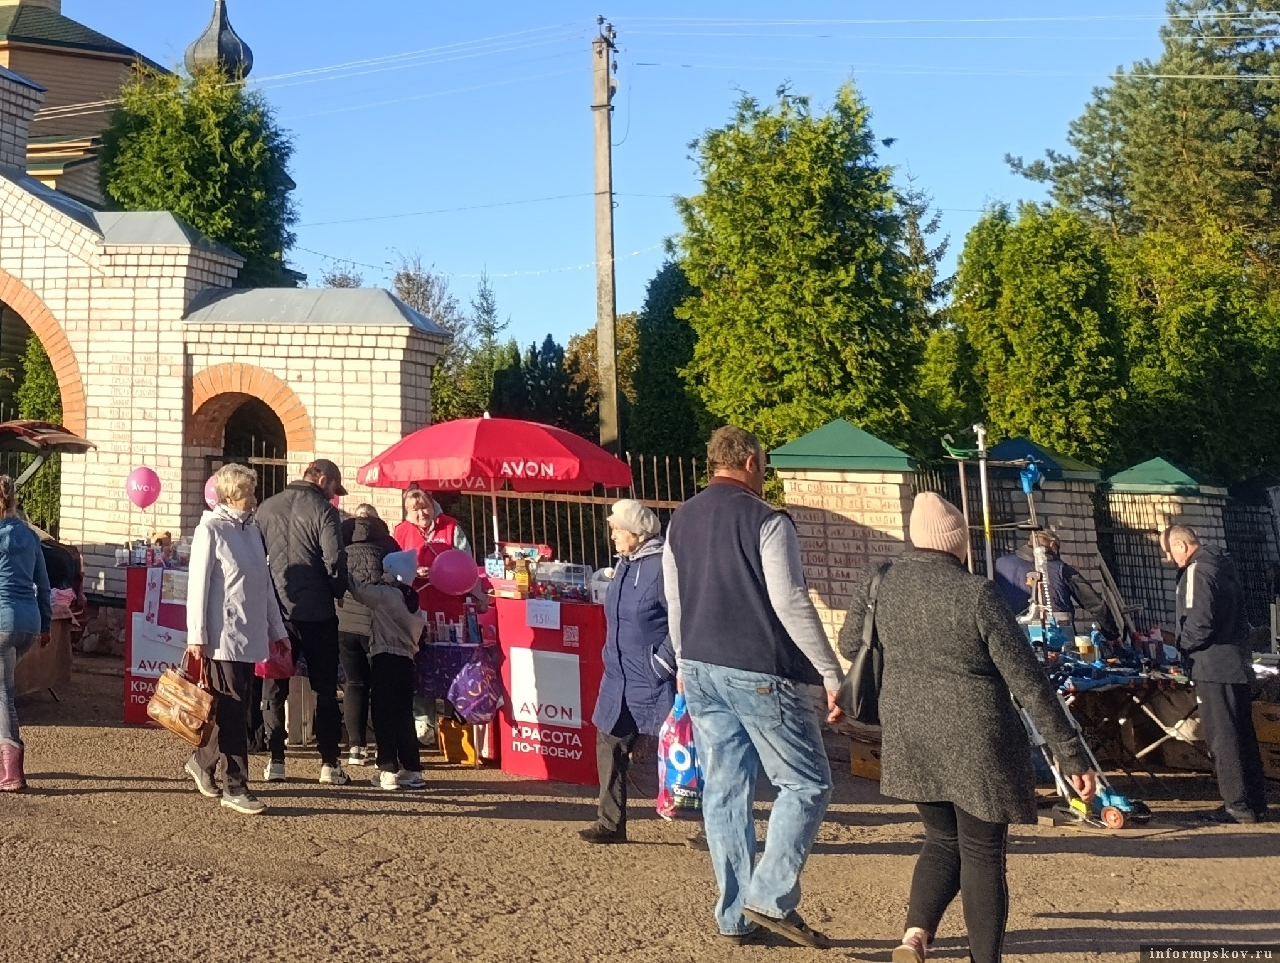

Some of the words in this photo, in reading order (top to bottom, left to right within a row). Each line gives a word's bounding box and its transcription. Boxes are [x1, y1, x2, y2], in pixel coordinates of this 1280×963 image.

[501, 461, 554, 476] AVON
[130, 680, 158, 694] КРА
[519, 702, 573, 721] AVON
[512, 726, 582, 747] КРАСОТА
[512, 742, 583, 760] ПО-ТВОЕМУ
